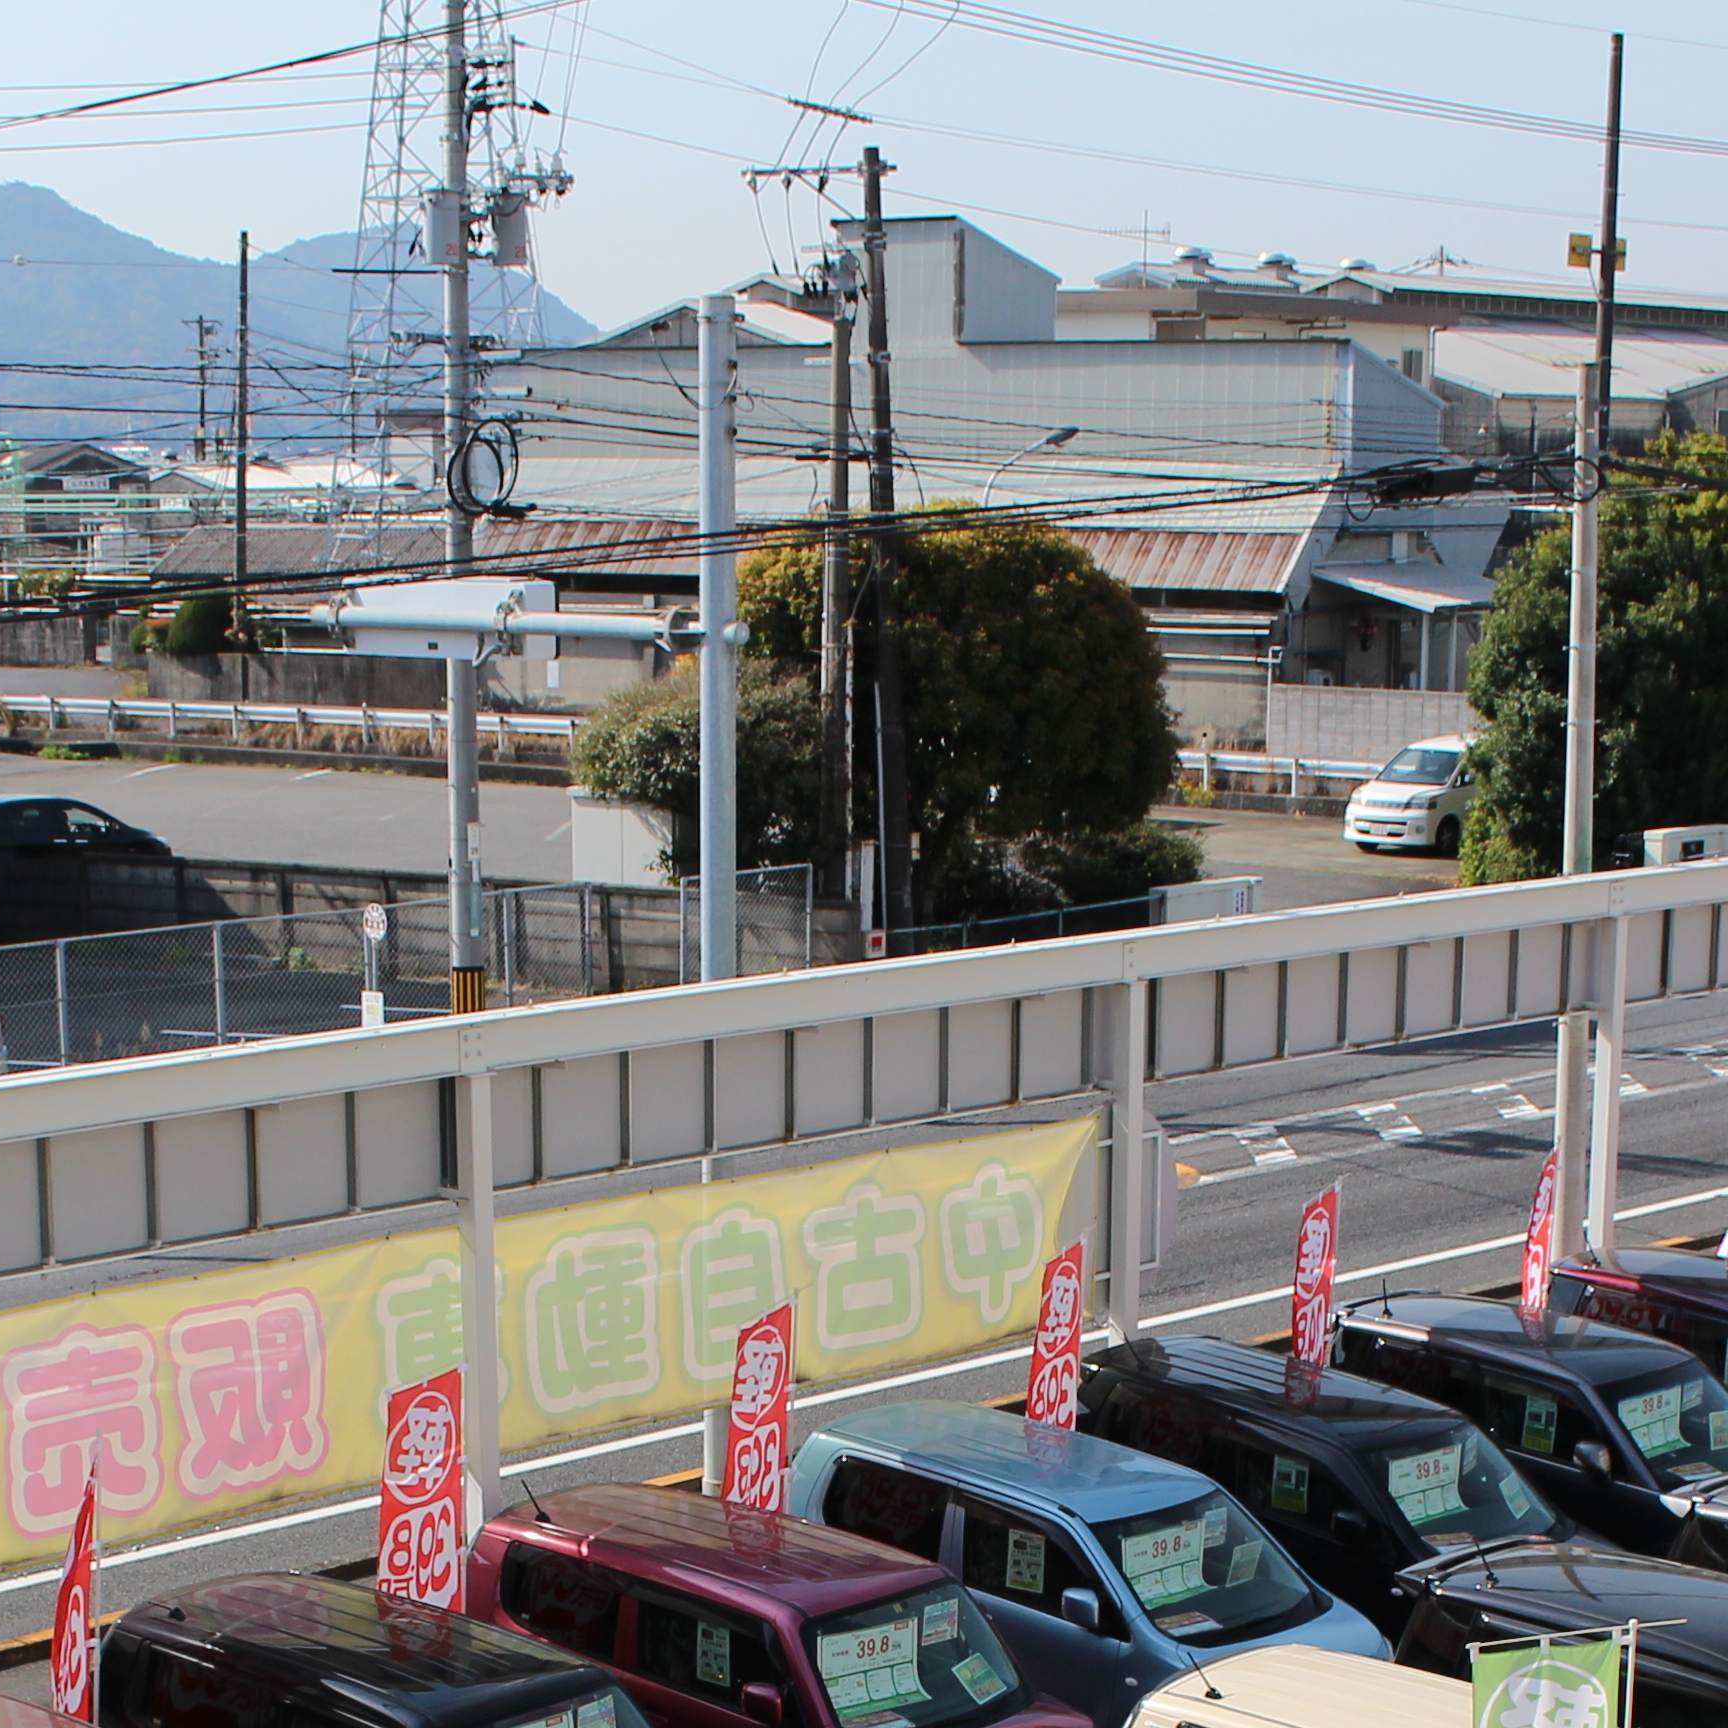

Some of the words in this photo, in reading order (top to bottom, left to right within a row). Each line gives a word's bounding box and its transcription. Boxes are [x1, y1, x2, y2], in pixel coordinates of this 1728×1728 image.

[1416, 1459, 1441, 1480] 39.8
[1152, 1535, 1182, 1560] 39.8
[856, 1635, 891, 1660] 39.8
